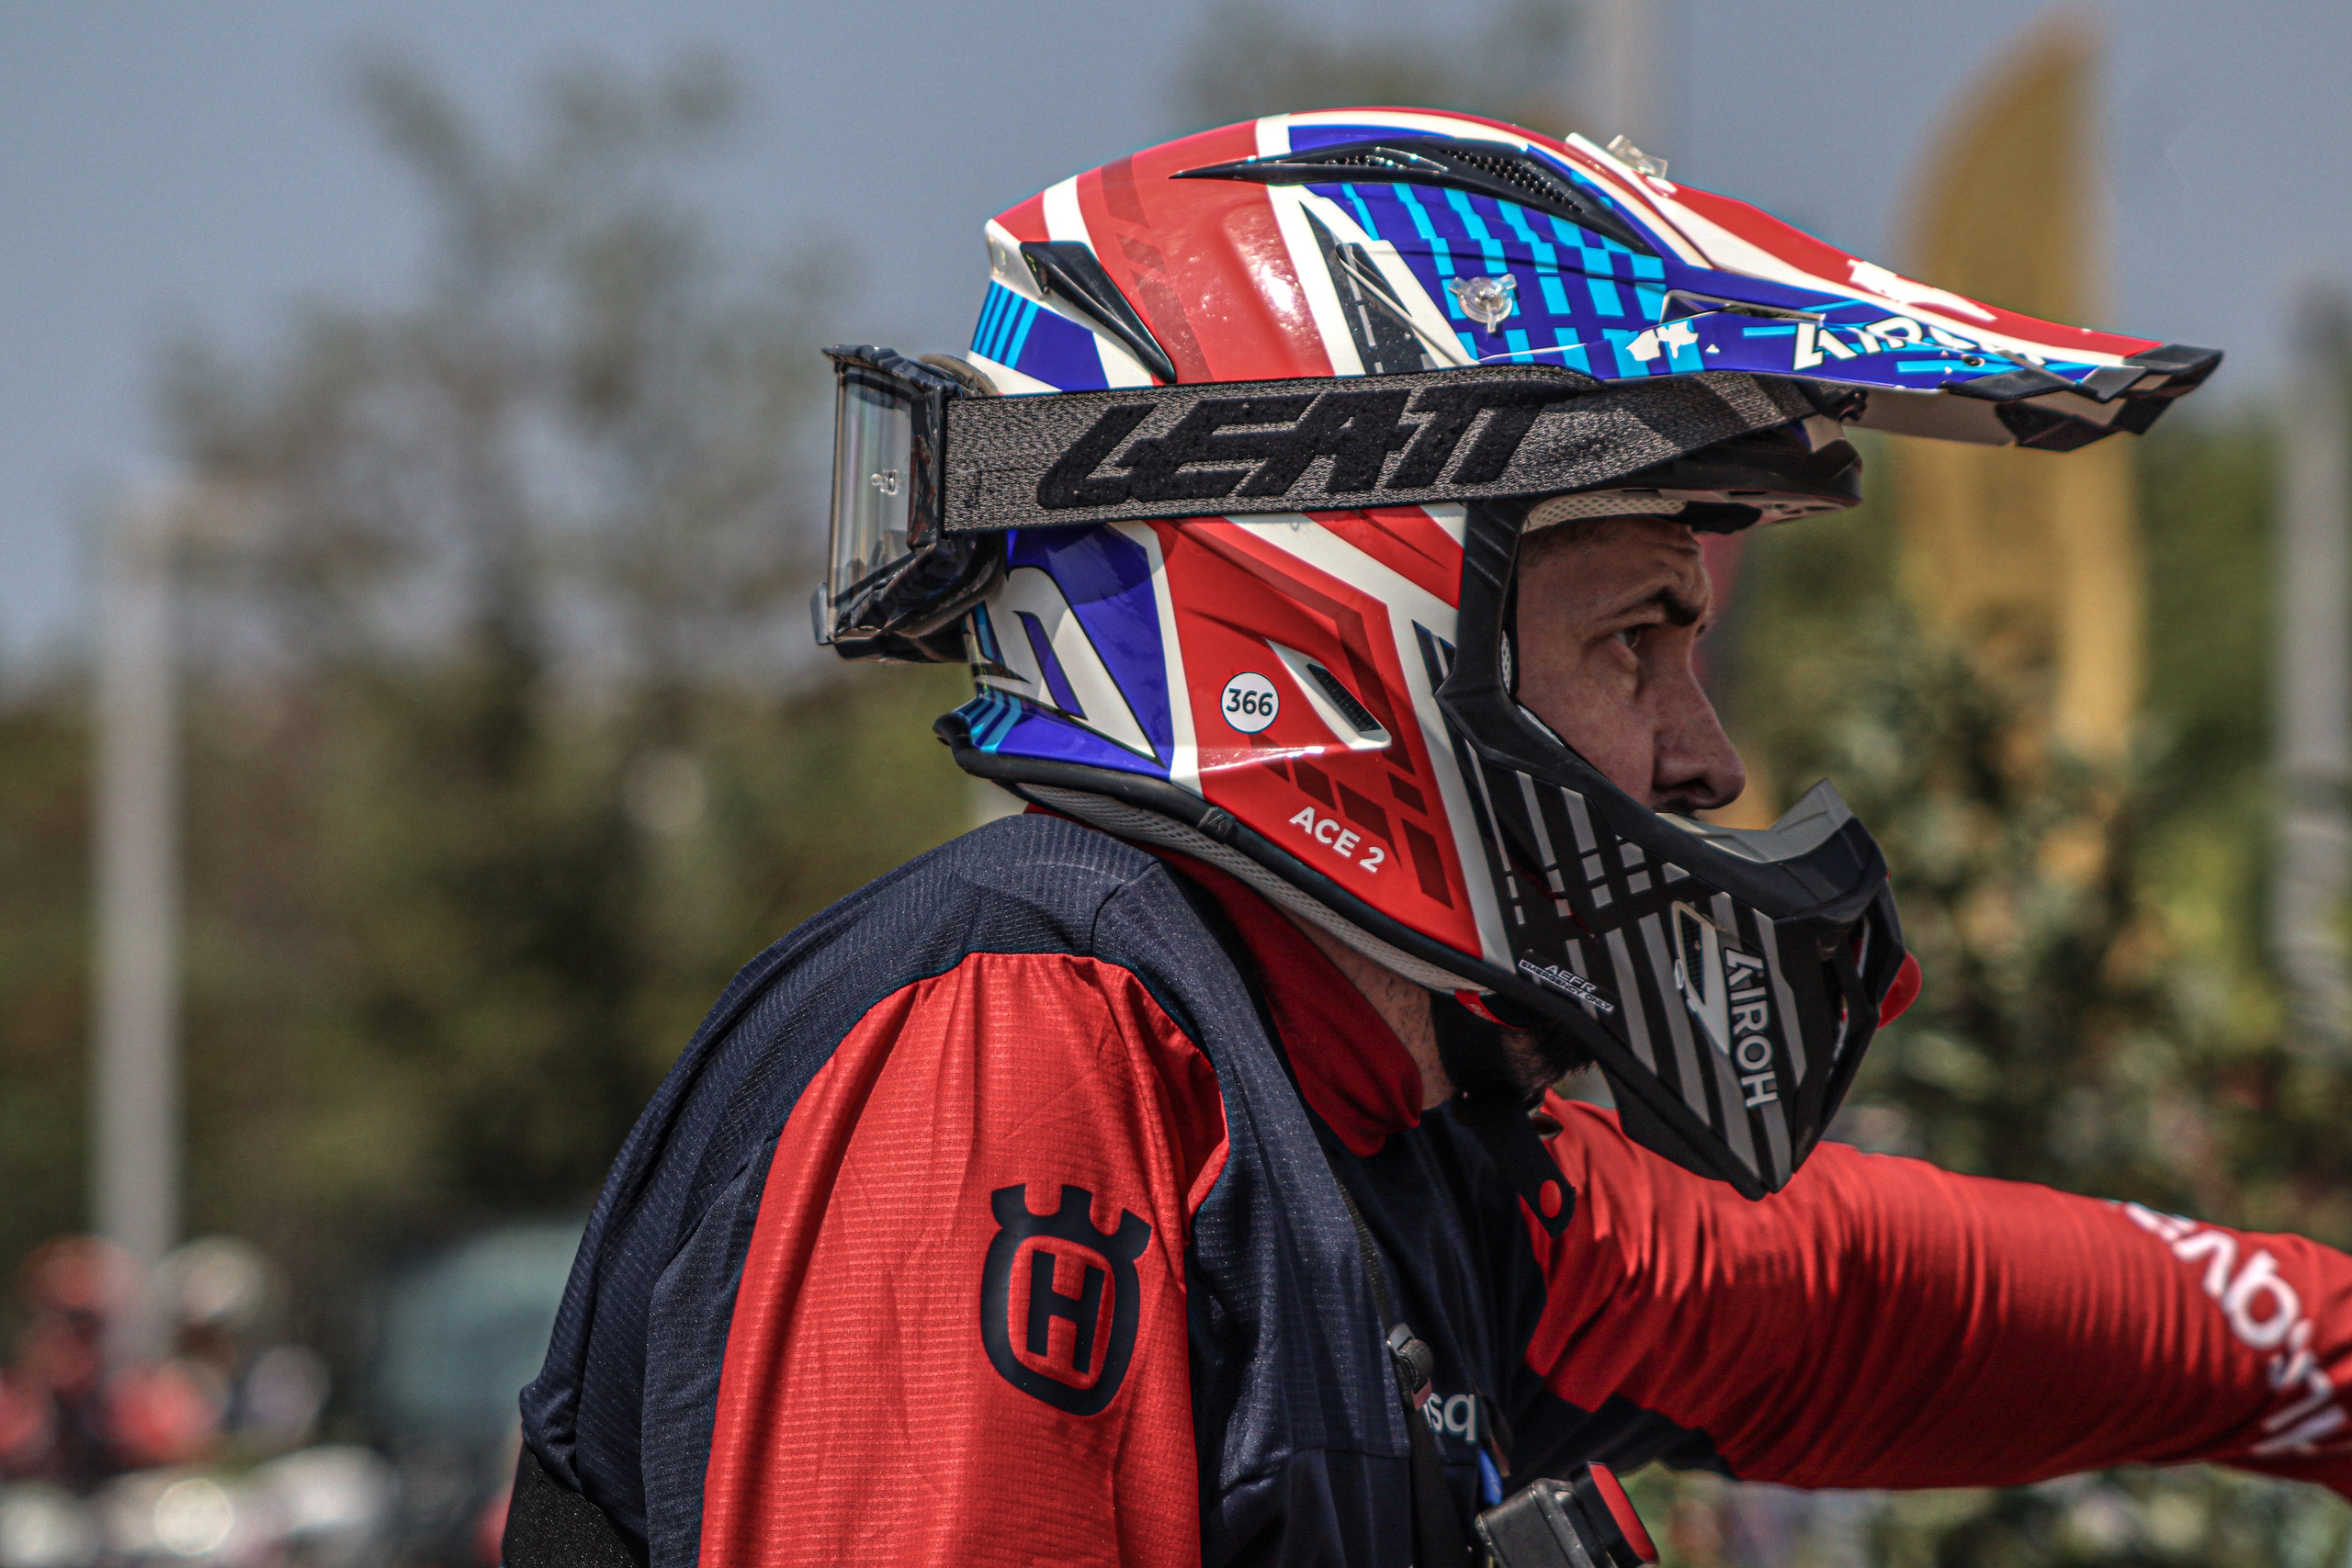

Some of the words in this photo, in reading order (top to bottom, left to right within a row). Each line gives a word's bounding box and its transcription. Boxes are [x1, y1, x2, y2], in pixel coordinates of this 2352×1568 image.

[1226, 687, 1273, 716] 366
[1289, 806, 1361, 858] ACE
[1359, 846, 1385, 873] 2
[1521, 961, 1583, 996] EMERGENCY
[1584, 994, 1612, 1010] ONLY
[1544, 964, 1597, 992] AEFR
[1725, 947, 1779, 1109] AIROH
